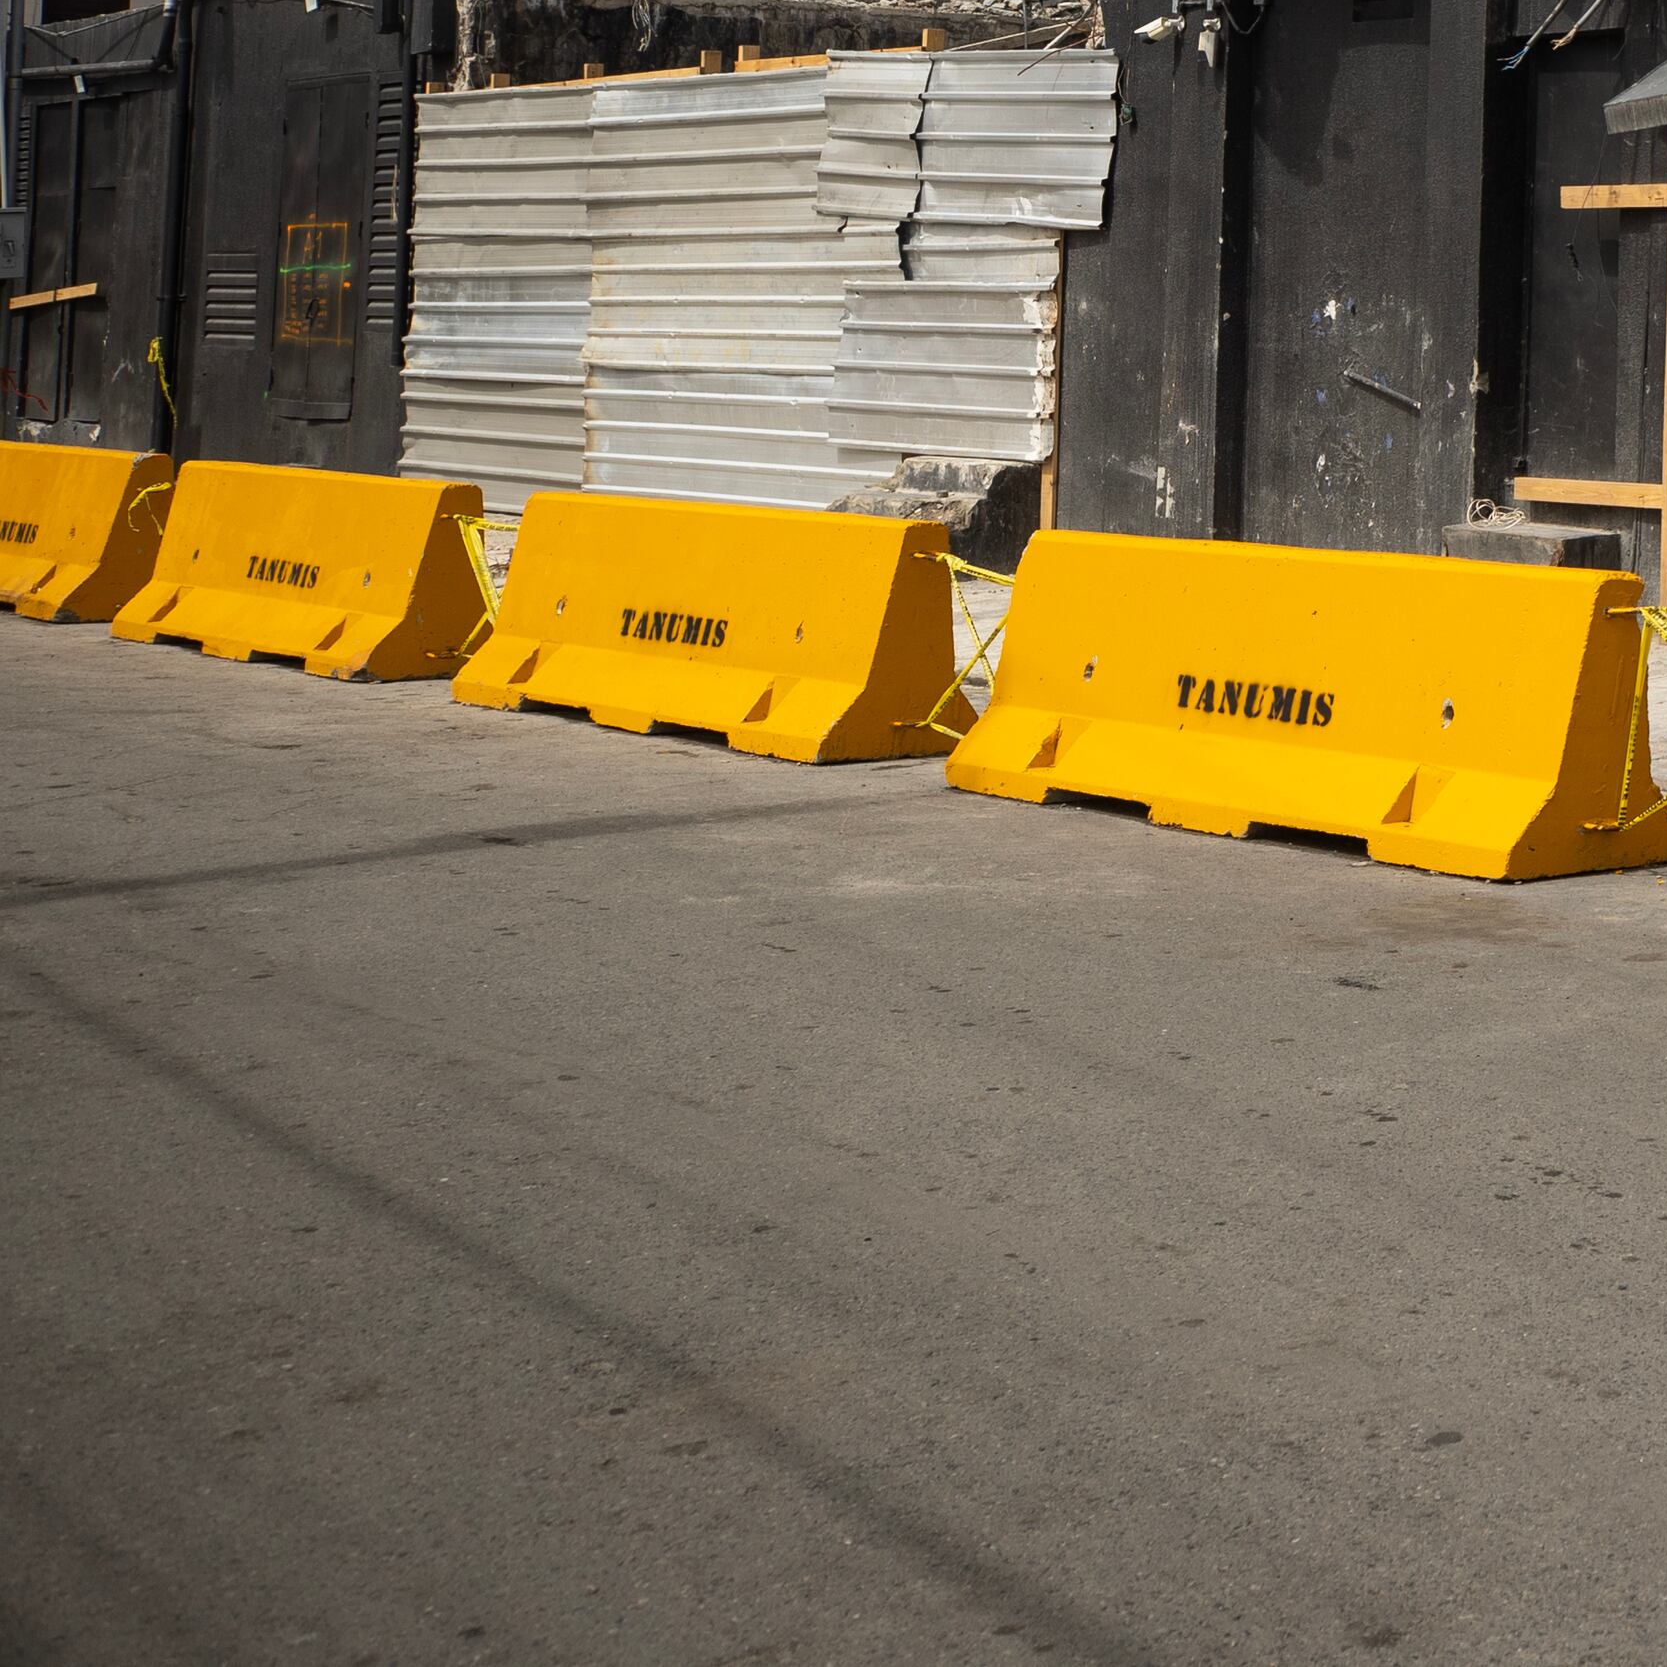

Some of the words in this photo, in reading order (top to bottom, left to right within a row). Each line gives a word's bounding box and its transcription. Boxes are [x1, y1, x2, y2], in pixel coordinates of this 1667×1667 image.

[0, 520, 39, 544] NUMIS
[246, 555, 320, 589] TANUMIS
[620, 608, 728, 647] TANUMIS
[1177, 674, 1335, 727] TANUMIS
